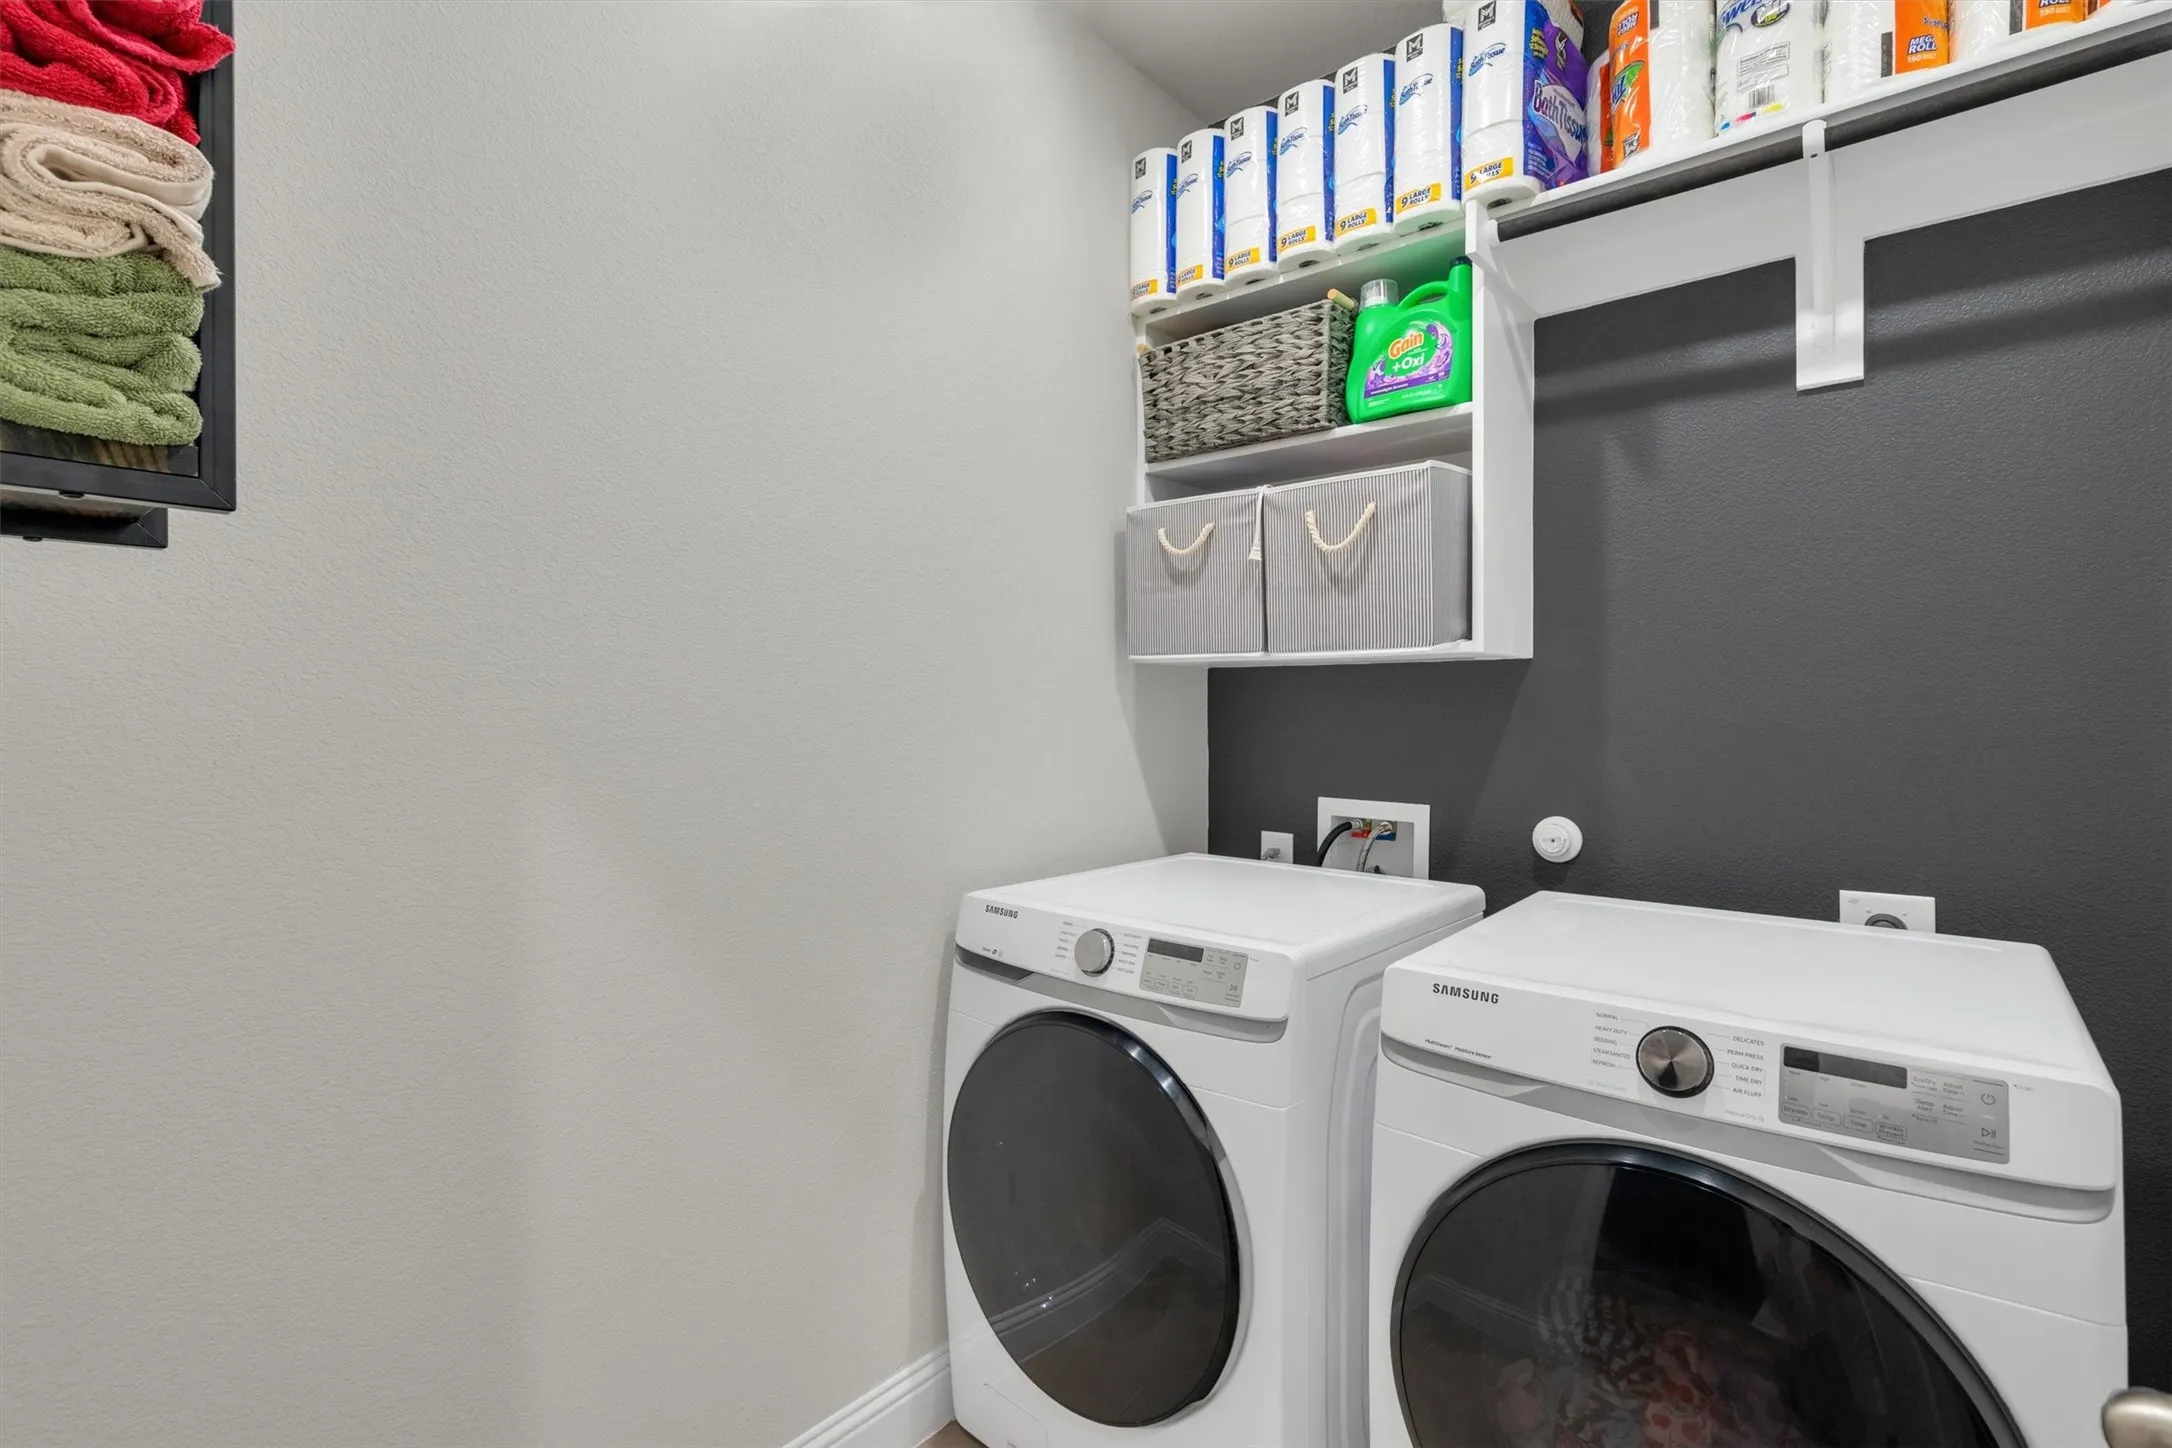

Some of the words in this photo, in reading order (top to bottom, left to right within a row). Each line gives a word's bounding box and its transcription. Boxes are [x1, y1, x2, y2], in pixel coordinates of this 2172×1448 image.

[1480, 161, 1502, 174] LARGE
[1401, 197, 1408, 208] 9
[1409, 187, 1431, 200] LARGE
[1340, 220, 1347, 231] 9
[1347, 212, 1367, 223] LARGE
[1281, 237, 1287, 248] 9
[1287, 230, 1306, 240] LARGE
[1228, 258, 1234, 268] 9
[1388, 332, 1424, 359] Gain
[985, 904, 1019, 919] SAMSUNG
[1432, 983, 1499, 1004] SAMSUNG
[1733, 1036, 1764, 1046] DELICATES
[1727, 1049, 1743, 1057] PERM
[1745, 1053, 1764, 1061] PRESS
[1731, 1062, 1750, 1071] QUICK
[1735, 1075, 1749, 1083] TIME
[1733, 1087, 1743, 1095] AIR
